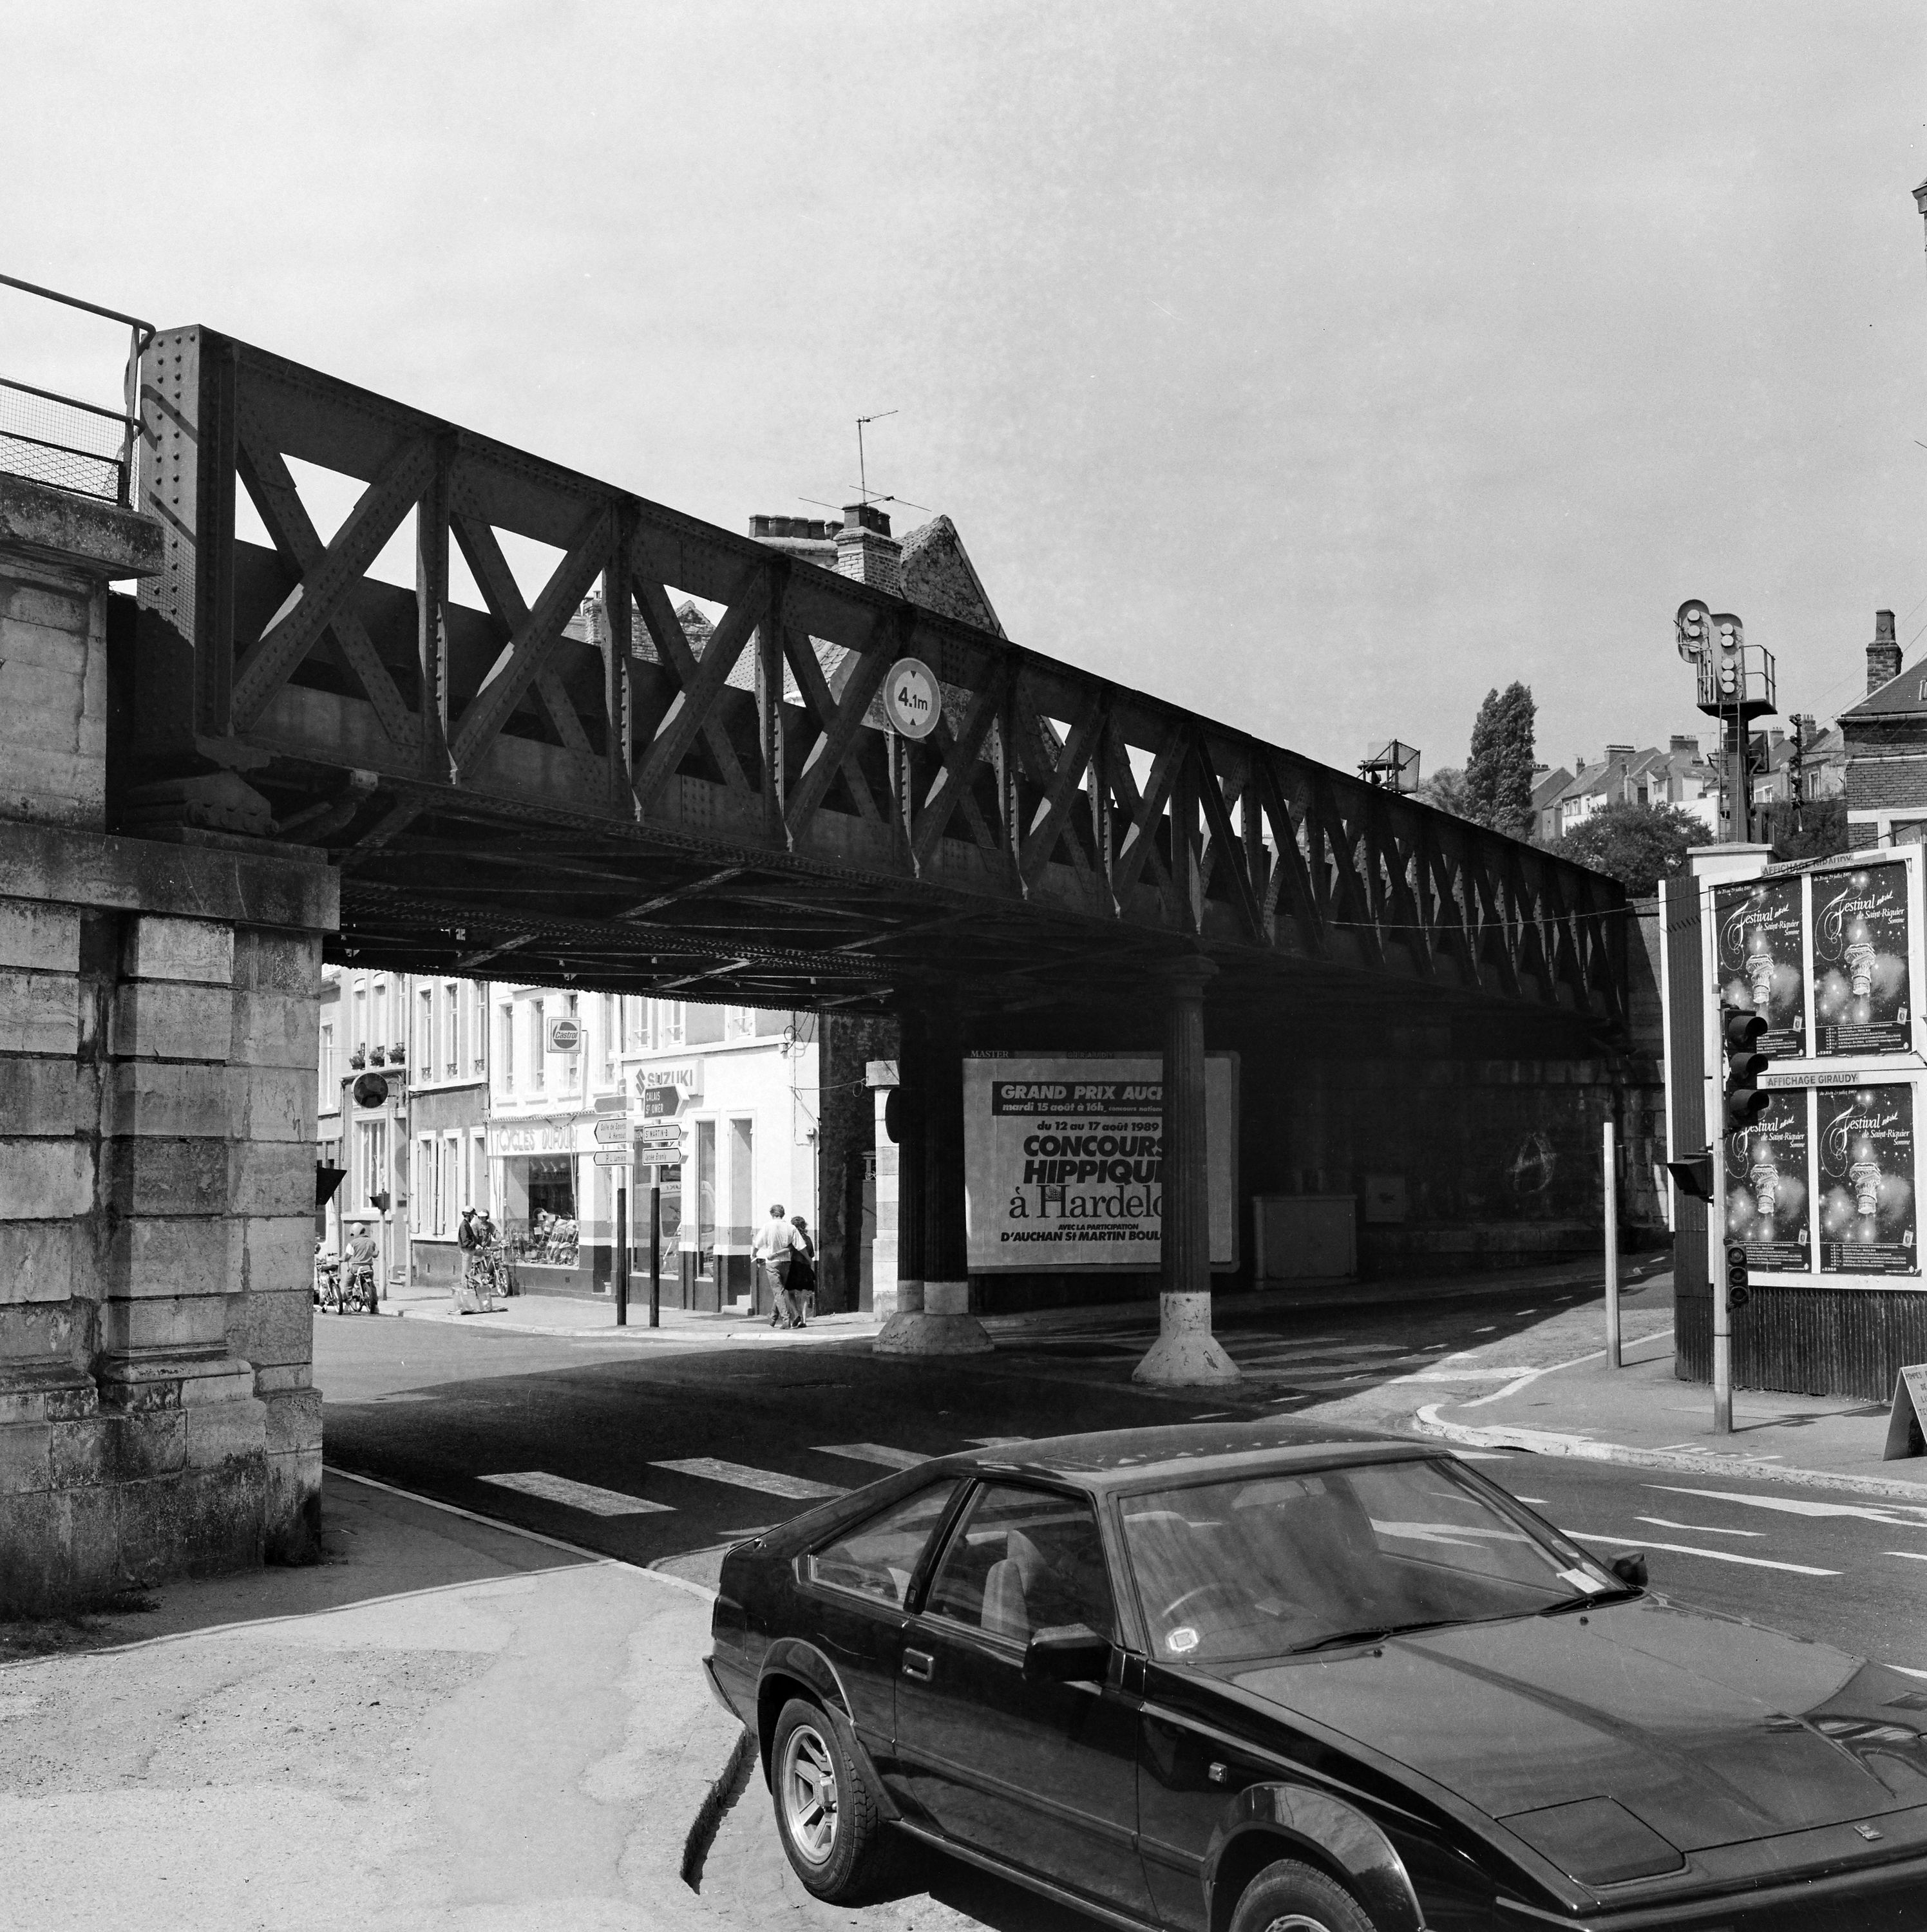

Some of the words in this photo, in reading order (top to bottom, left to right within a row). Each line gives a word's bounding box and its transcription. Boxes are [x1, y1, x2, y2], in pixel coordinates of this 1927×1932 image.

[898, 687, 928, 711] 4.1m
[1856, 911, 1864, 920] de
[1865, 907, 1904, 920] Saint-Riquier
[1756, 923, 1763, 931] de
[1763, 920, 1799, 931] Saint-Riquier
[647, 1069, 693, 1087] SUZUKI
[1818, 1074, 1857, 1084] GIRAUDY
[646, 1091, 660, 1101] CALAIS
[1001, 1085, 1067, 1099] GRAND
[1074, 1086, 1117, 1100] PRIX
[651, 1103, 663, 1113] OMER
[1002, 1102, 1034, 1112] mardi
[1037, 1103, 1049, 1112] 15
[1050, 1103, 1075, 1112] août
[1077, 1103, 1085, 1112] à
[1037, 1121, 1052, 1131] du
[1056, 1121, 1068, 1131] 12
[1088, 1121, 1101, 1131] 17
[1102, 1122, 1128, 1132] août
[1131, 1122, 1159, 1132] 1989
[1761, 1132, 1769, 1141] de
[1769, 1132, 1805, 1142] Saint-Riquier
[1861, 1129, 1869, 1138] de
[1870, 1128, 1910, 1139] Saint-Riquier
[500, 1128, 535, 1151] CYCLES
[1009, 1186, 1030, 1218] à
[1001, 1231, 1063, 1242] D'AUCHAN
[1065, 1231, 1077, 1242] St
[1078, 1231, 1126, 1241] MARTIN
[1128, 1231, 1162, 1240] BOUL
